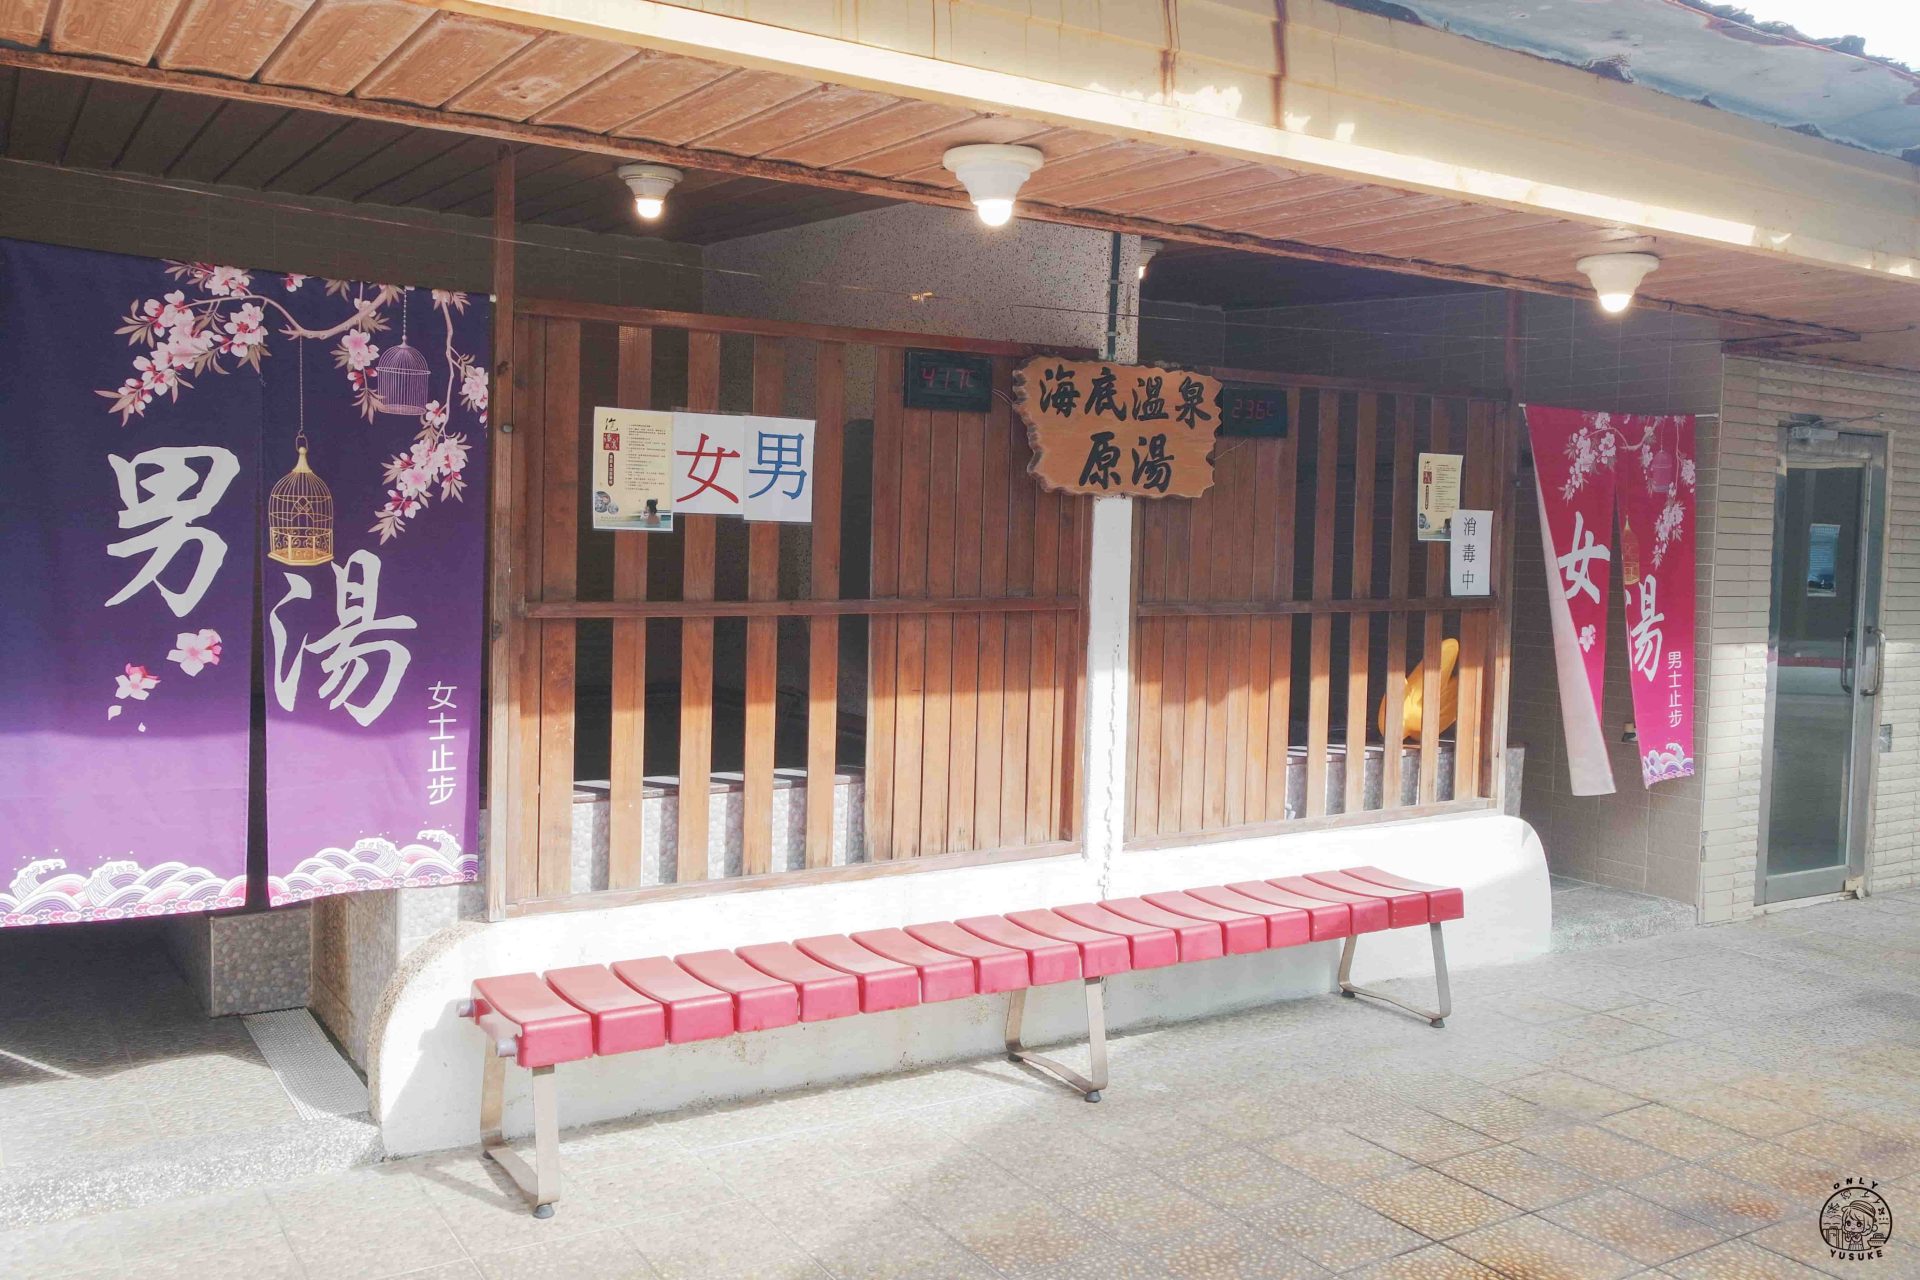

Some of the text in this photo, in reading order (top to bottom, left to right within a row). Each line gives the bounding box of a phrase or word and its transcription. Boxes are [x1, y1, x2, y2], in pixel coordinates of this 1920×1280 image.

[676, 432, 741, 504] 女
[748, 430, 807, 500] 男
[1079, 431, 1175, 493] 原湯
[1462, 516, 1478, 591] 消毒中
[1667, 650, 1683, 729] 男士止步
[427, 680, 459, 805] 女士止步
